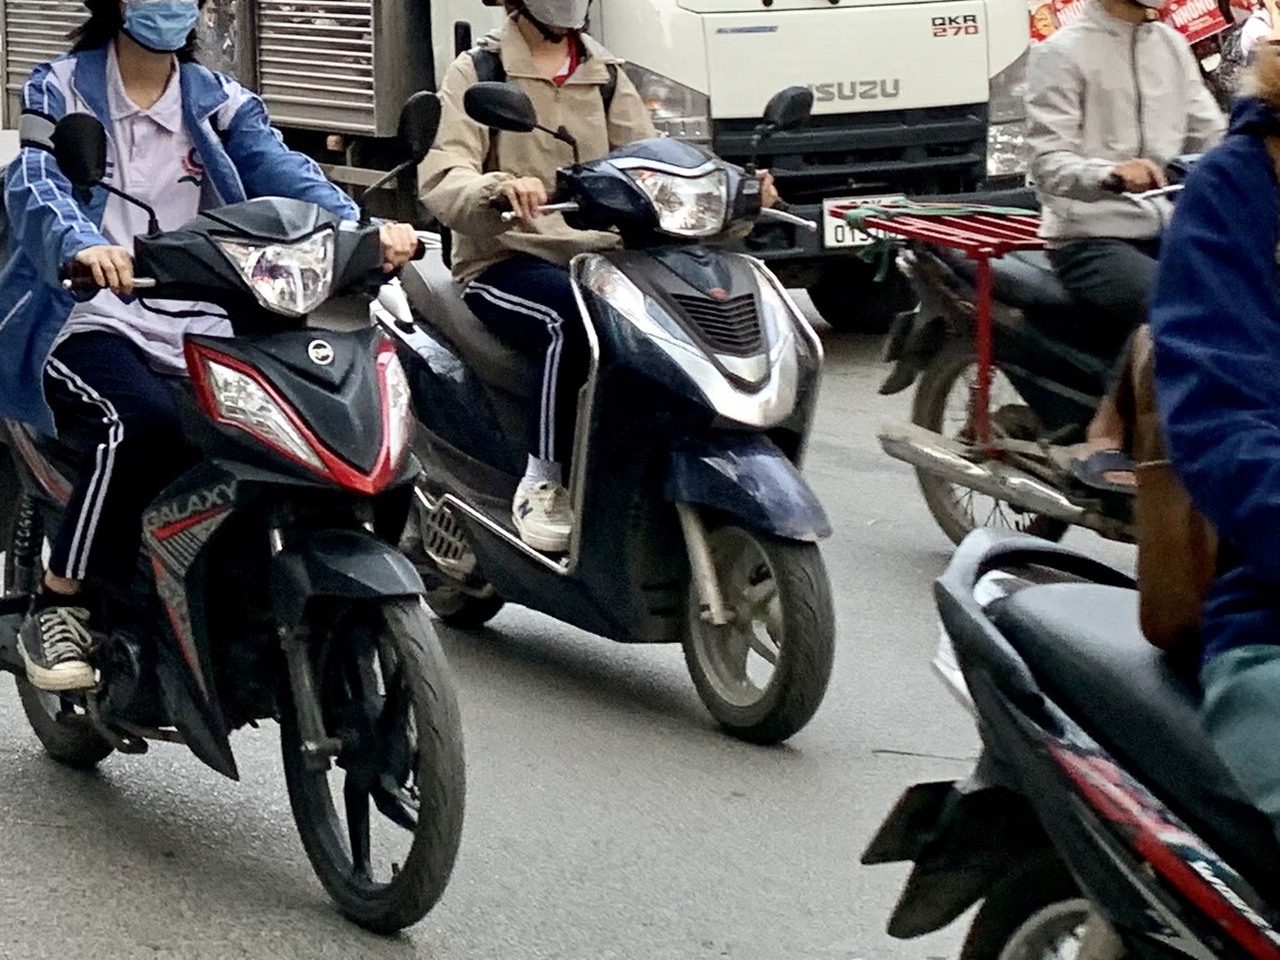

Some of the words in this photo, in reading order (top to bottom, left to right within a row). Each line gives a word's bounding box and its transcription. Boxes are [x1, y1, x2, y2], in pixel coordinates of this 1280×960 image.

[931, 14, 978, 27] QKR
[932, 25, 979, 38] 270
[142, 480, 238, 530] GALAXY
